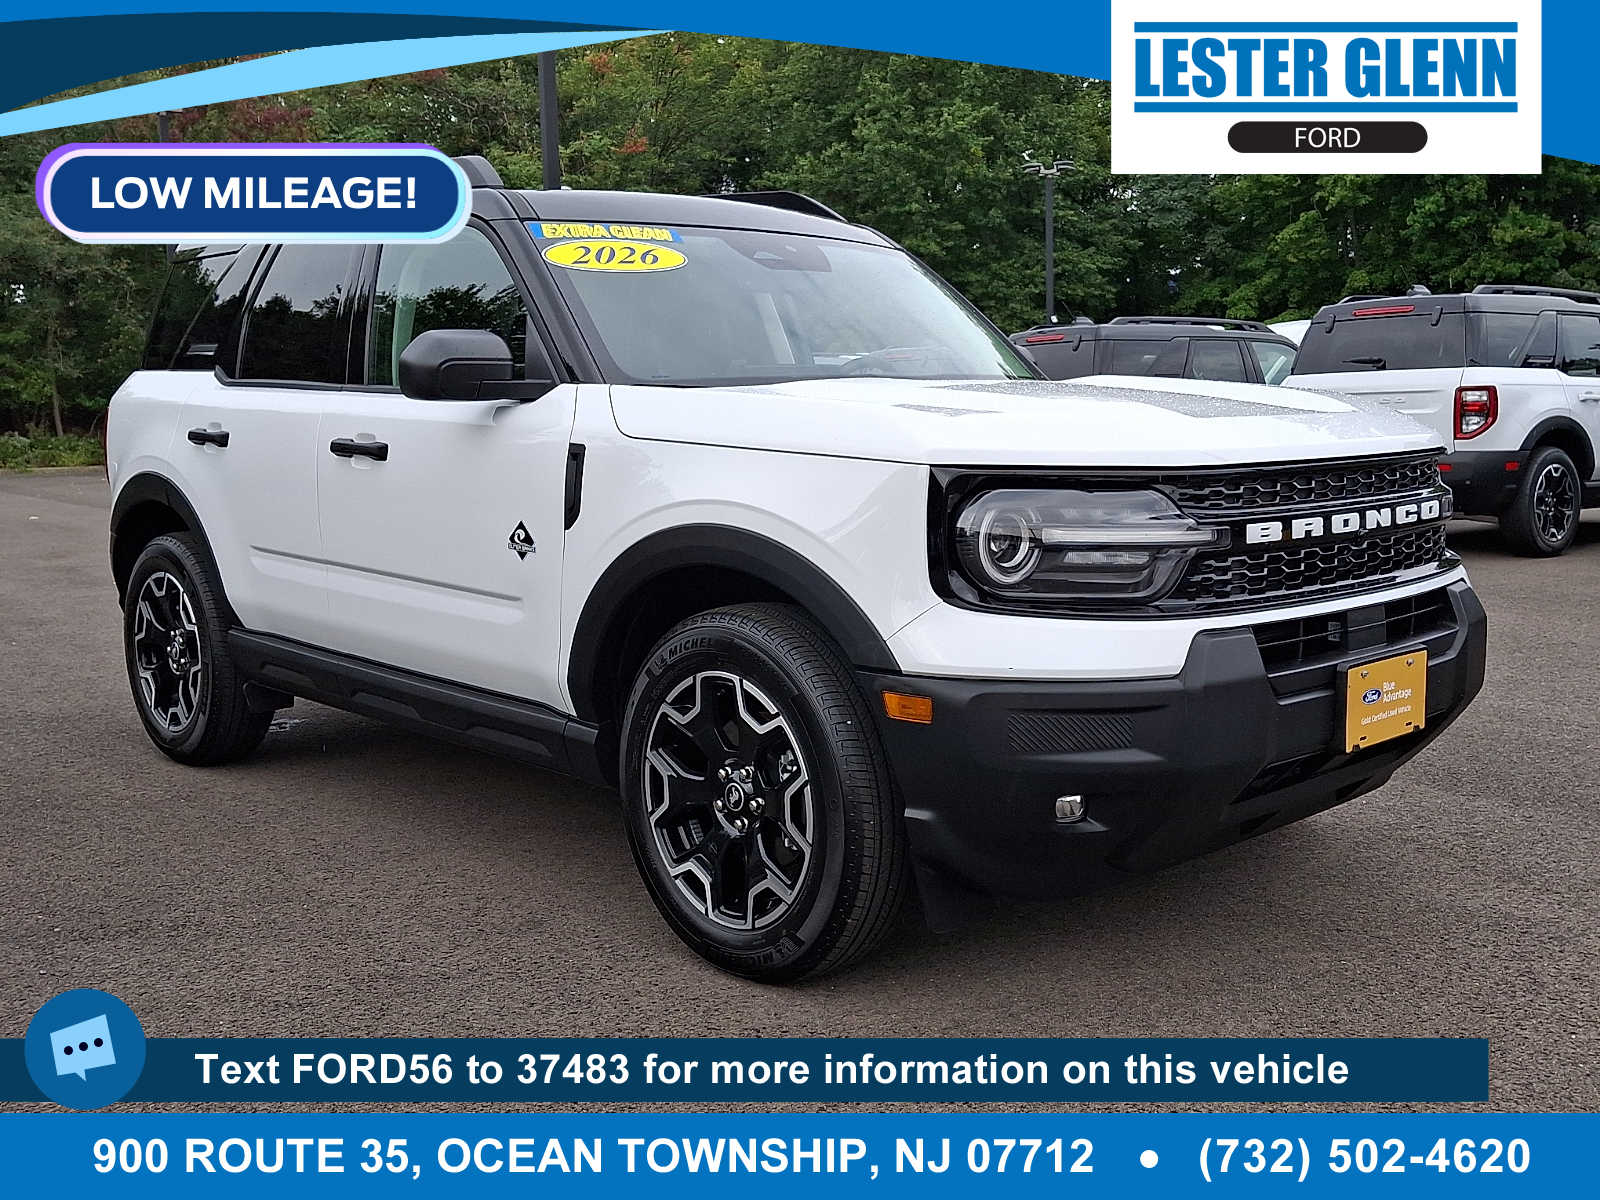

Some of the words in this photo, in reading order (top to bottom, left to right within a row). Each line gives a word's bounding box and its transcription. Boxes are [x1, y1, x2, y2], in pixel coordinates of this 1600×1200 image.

[541, 223, 611, 239] EXTRA
[609, 225, 673, 242] CLEAN
[571, 245, 660, 265] 2026
[1246, 500, 1440, 544] BRONCO
[1383, 681, 1396, 692] Blue
[1383, 688, 1412, 703] Advantage
